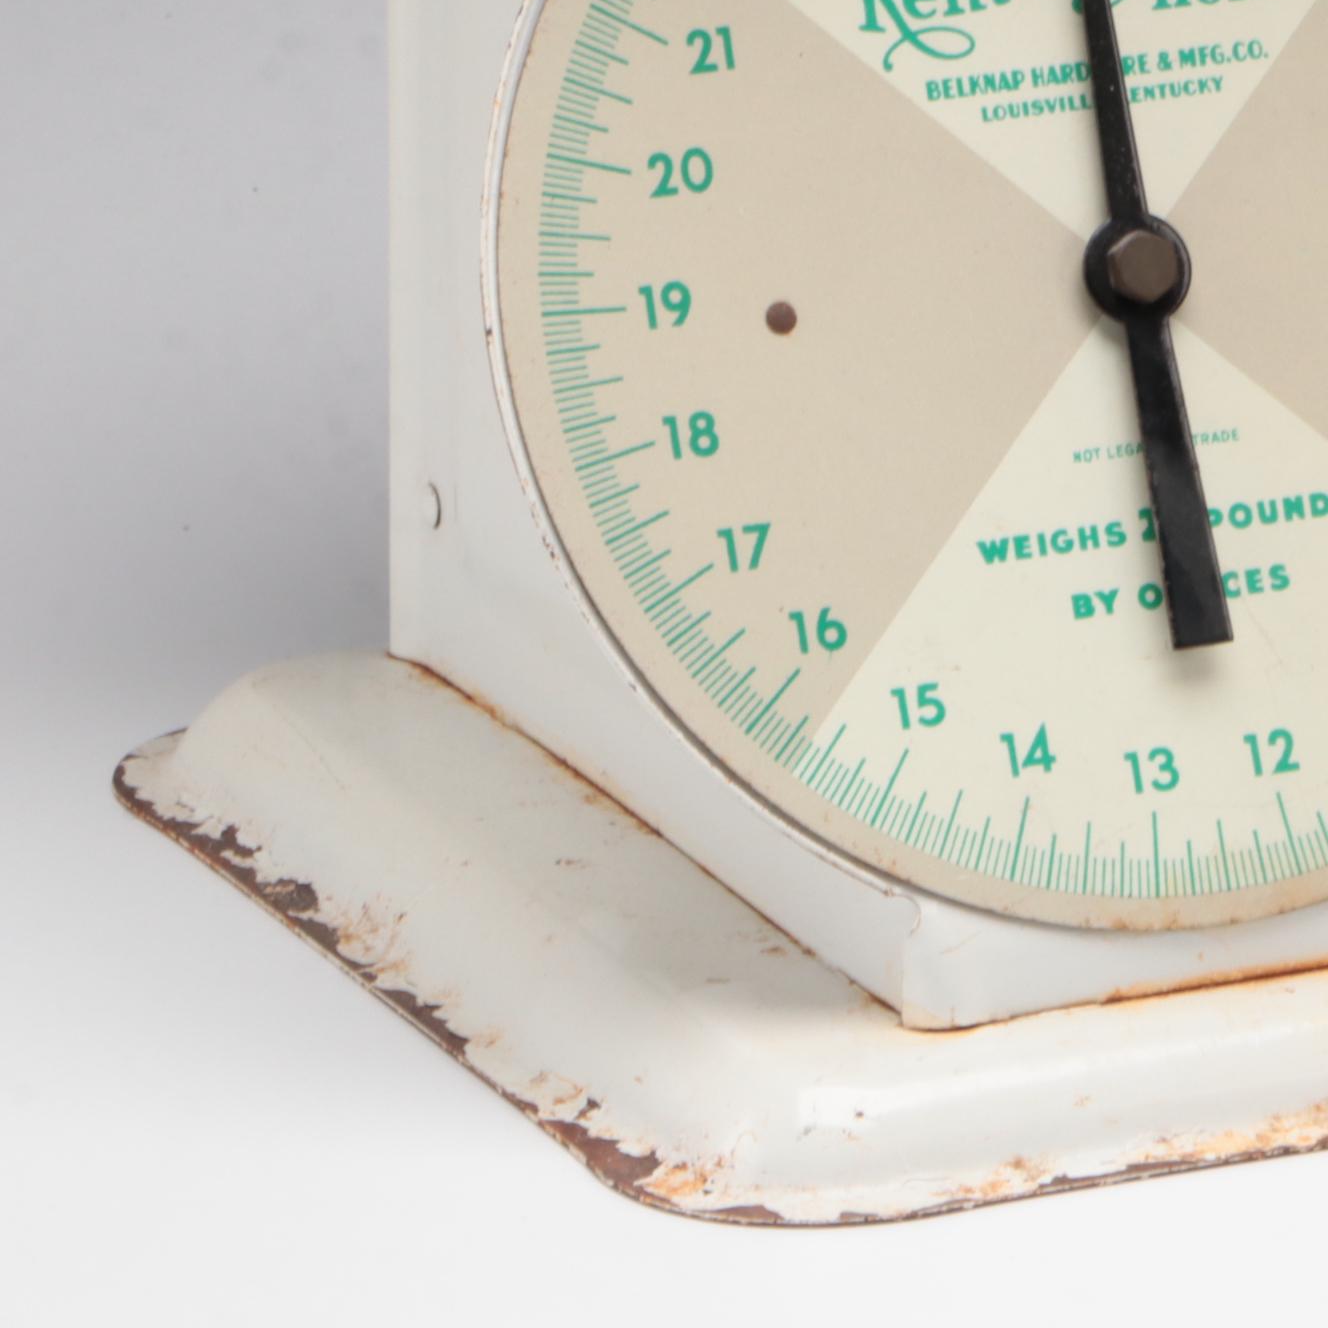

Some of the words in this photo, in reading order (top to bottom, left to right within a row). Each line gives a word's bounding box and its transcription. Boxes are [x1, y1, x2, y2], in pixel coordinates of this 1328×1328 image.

[686, 25, 735, 75] 21
[926, 70, 1025, 102] BELKNAP
[1031, 54, 1151, 89] HARDRE
[1156, 51, 1173, 71] &
[980, 92, 1095, 123] LOUISVILL
[1127, 76, 1224, 104] ENTUCKY
[647, 147, 714, 198] 20
[639, 280, 692, 329] 19
[663, 411, 720, 460] 18
[1072, 447, 1101, 463] NOT
[1106, 442, 1145, 459] LEGA
[718, 523, 771, 572] 17
[977, 520, 1127, 564] WEIGHS
[1072, 588, 1120, 620] BY
[1137, 563, 1291, 609] OCES
[789, 607, 848, 654] 16
[890, 681, 947, 730] 15
[999, 724, 1056, 778] 14
[1124, 746, 1180, 793] 13
[1243, 726, 1300, 776] 12
